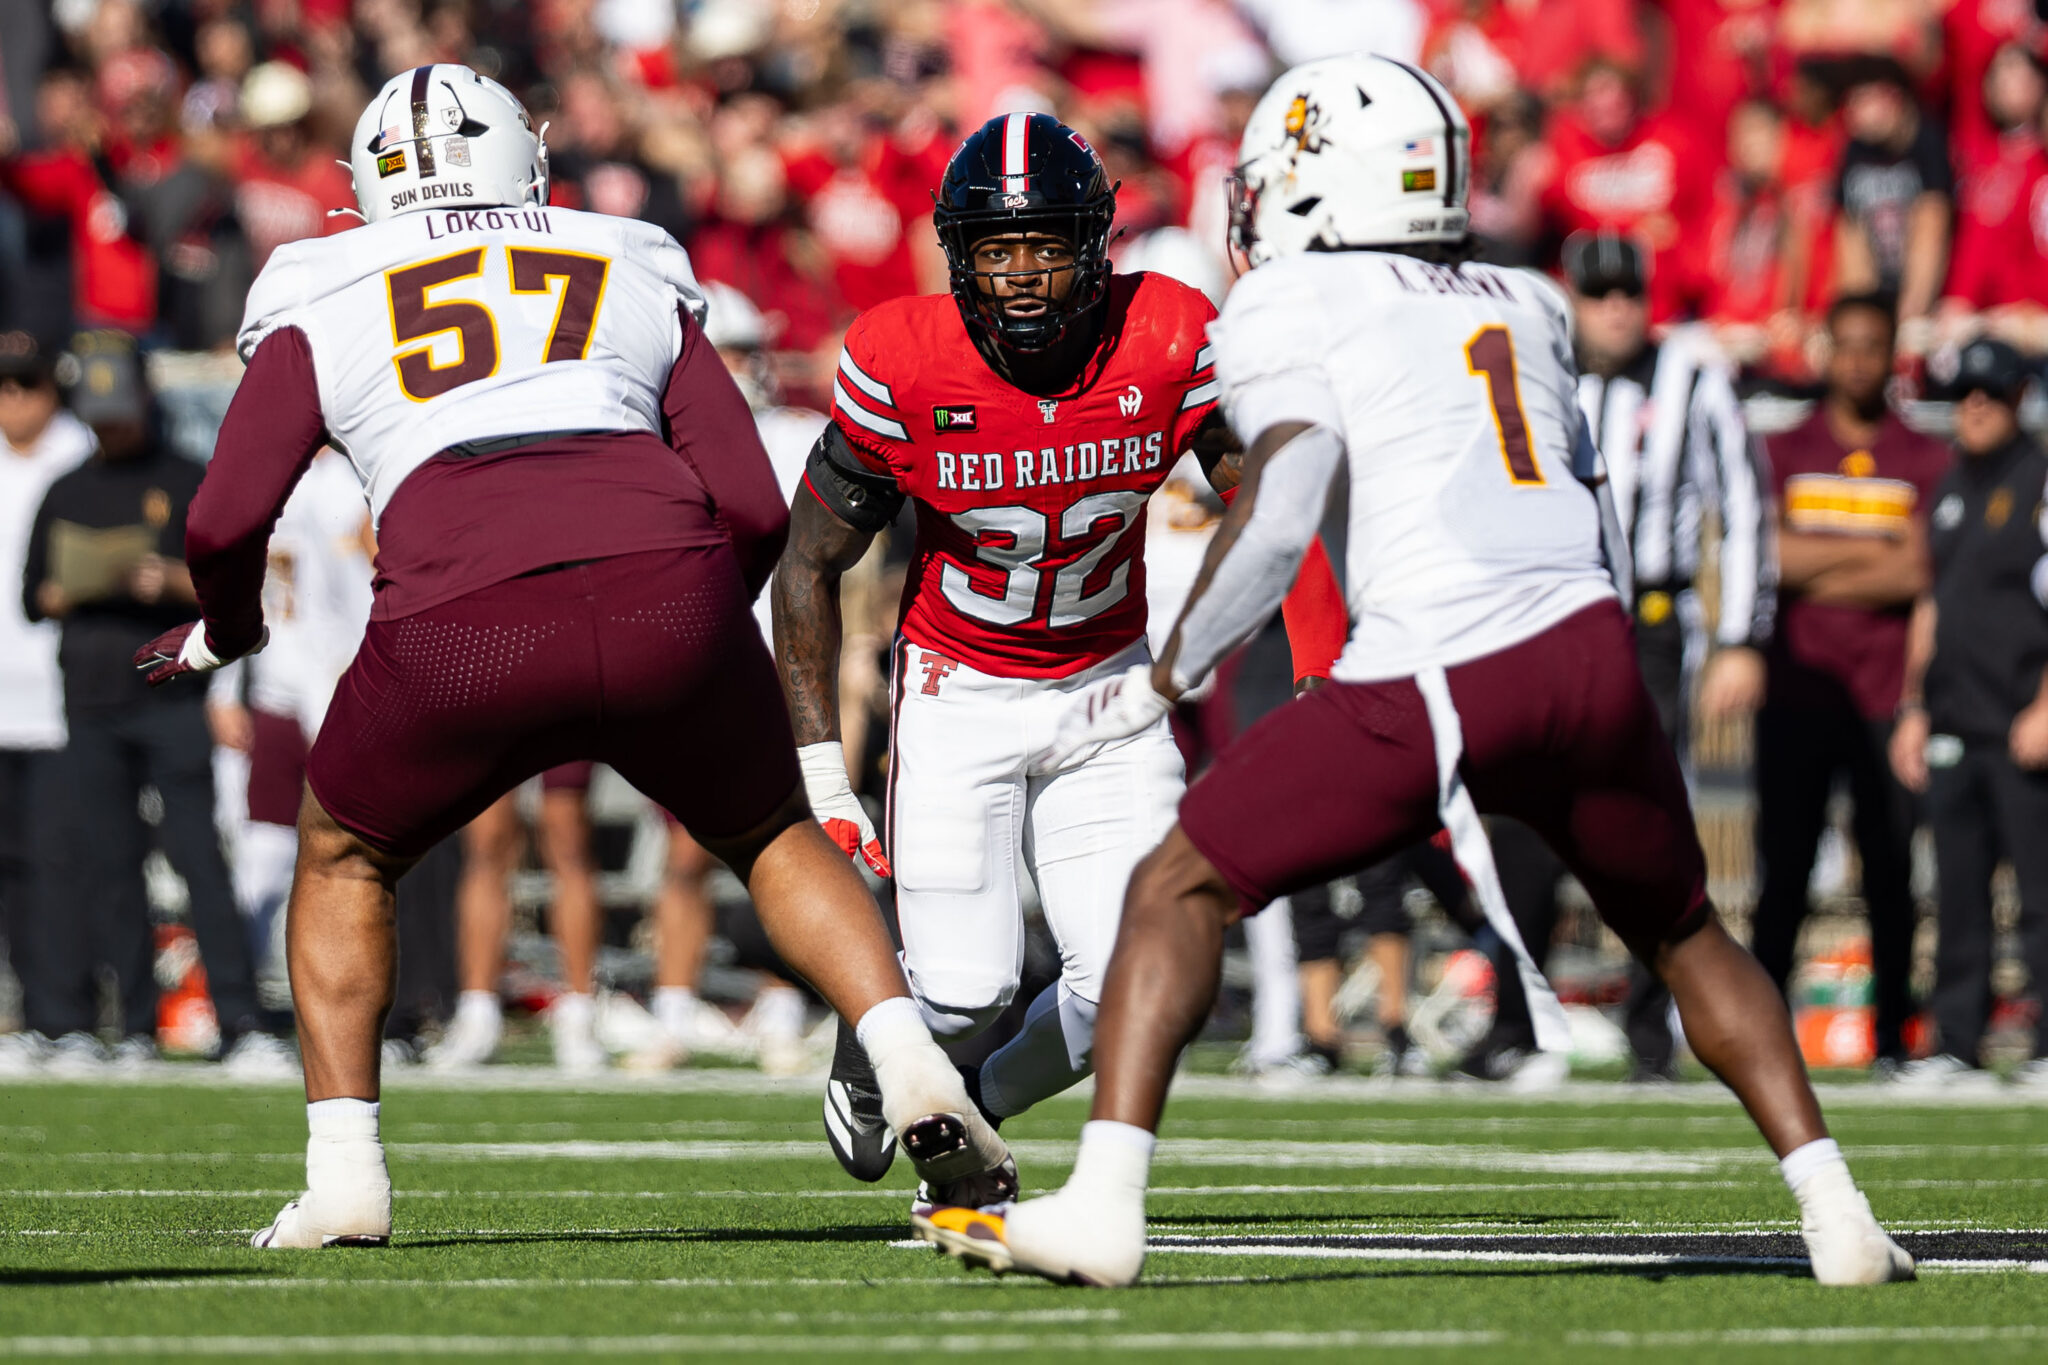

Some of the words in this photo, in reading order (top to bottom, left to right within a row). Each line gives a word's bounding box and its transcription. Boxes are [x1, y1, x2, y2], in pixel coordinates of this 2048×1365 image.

[391, 188, 417, 210] SUN
[422, 182, 474, 200] DEVILS
[426, 210, 553, 241] LOKOTUI
[1002, 192, 1029, 209] Tech
[383, 245, 613, 404] 57
[1463, 323, 1548, 486] 1
[936, 450, 1005, 491] RED
[1013, 430, 1165, 491] RAIDERS
[940, 489, 1152, 630] 32
